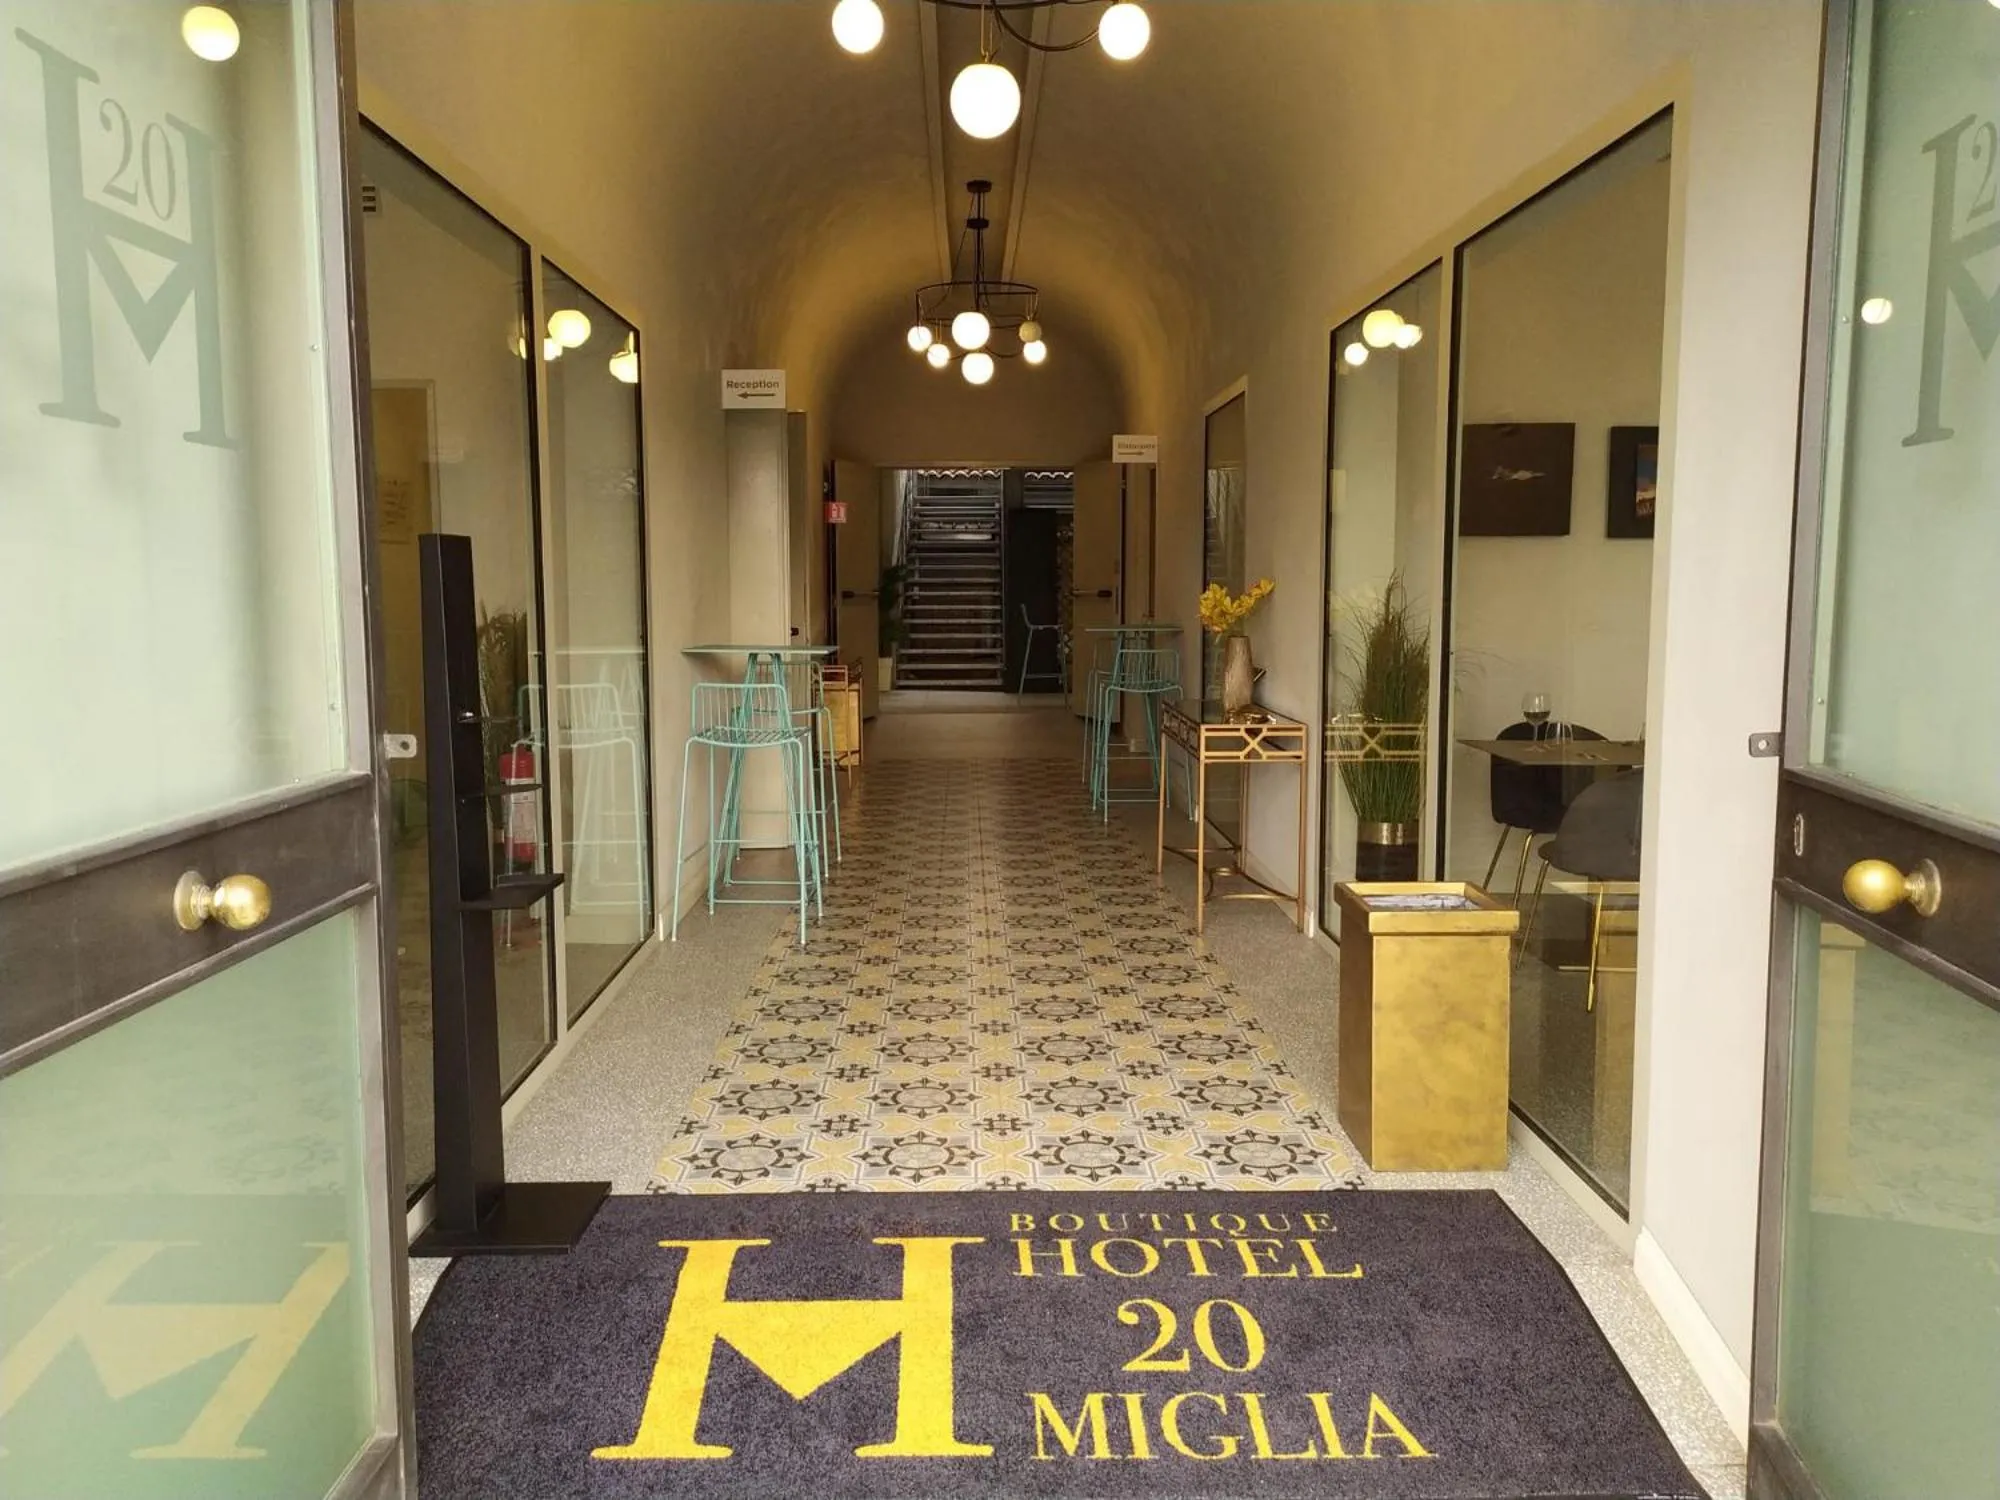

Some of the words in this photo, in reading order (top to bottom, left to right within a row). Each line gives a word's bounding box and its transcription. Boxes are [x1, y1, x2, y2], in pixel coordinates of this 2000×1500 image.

[99, 98, 176, 222] 20
[726, 379, 780, 390] Reception
[1010, 1213, 1338, 1237] BOUTIQUE
[1010, 1238, 1364, 1278] HOTEL
[1117, 1298, 1265, 1373] 20
[1025, 1391, 1439, 1460] MIGLIA
